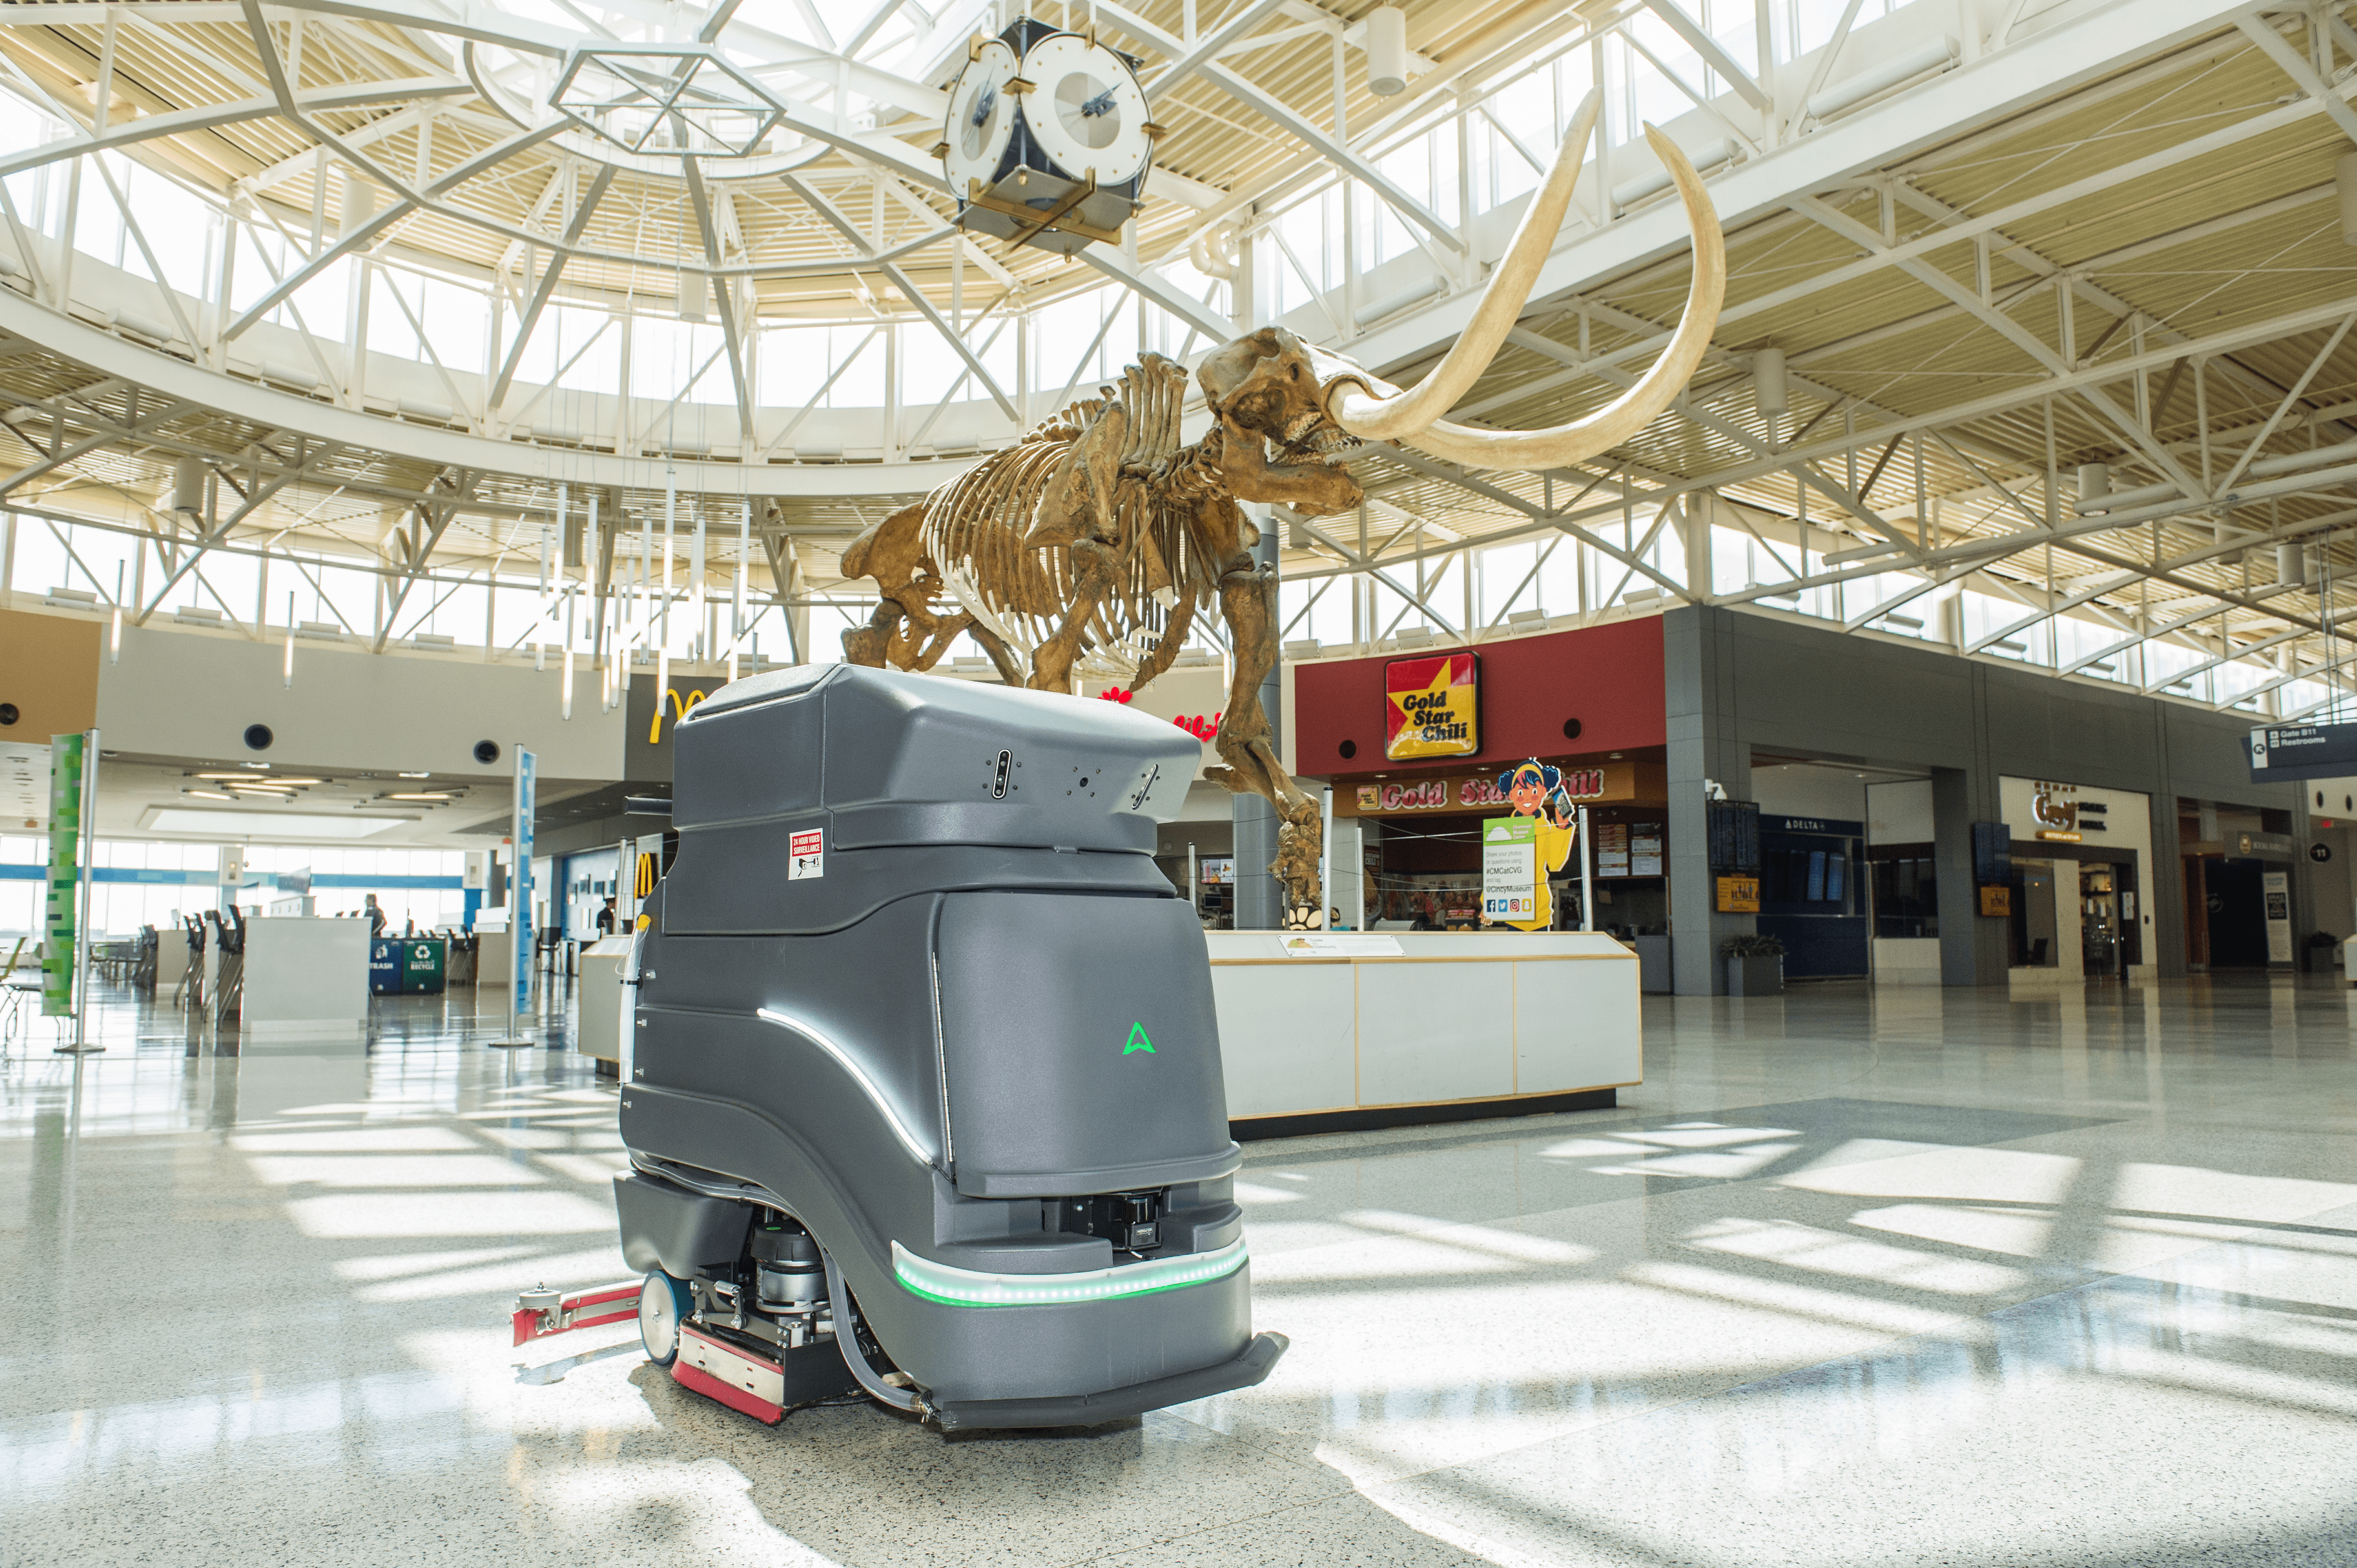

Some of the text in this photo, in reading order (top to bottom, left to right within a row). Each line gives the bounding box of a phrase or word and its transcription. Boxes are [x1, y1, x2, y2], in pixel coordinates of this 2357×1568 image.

[1403, 690, 1447, 711] Gold
[1413, 710, 1455, 726] Star
[1421, 722, 1467, 742] Chili
[2281, 737, 2326, 746] Restrooms
[1381, 781, 1447, 809] Gold
[1459, 778, 1515, 805] Sta
[1793, 818, 1818, 830] DELTA
[799, 837, 809, 845] HOUR
[809, 834, 820, 843] VIDEO
[794, 844, 820, 854] SURVEILLANCE
